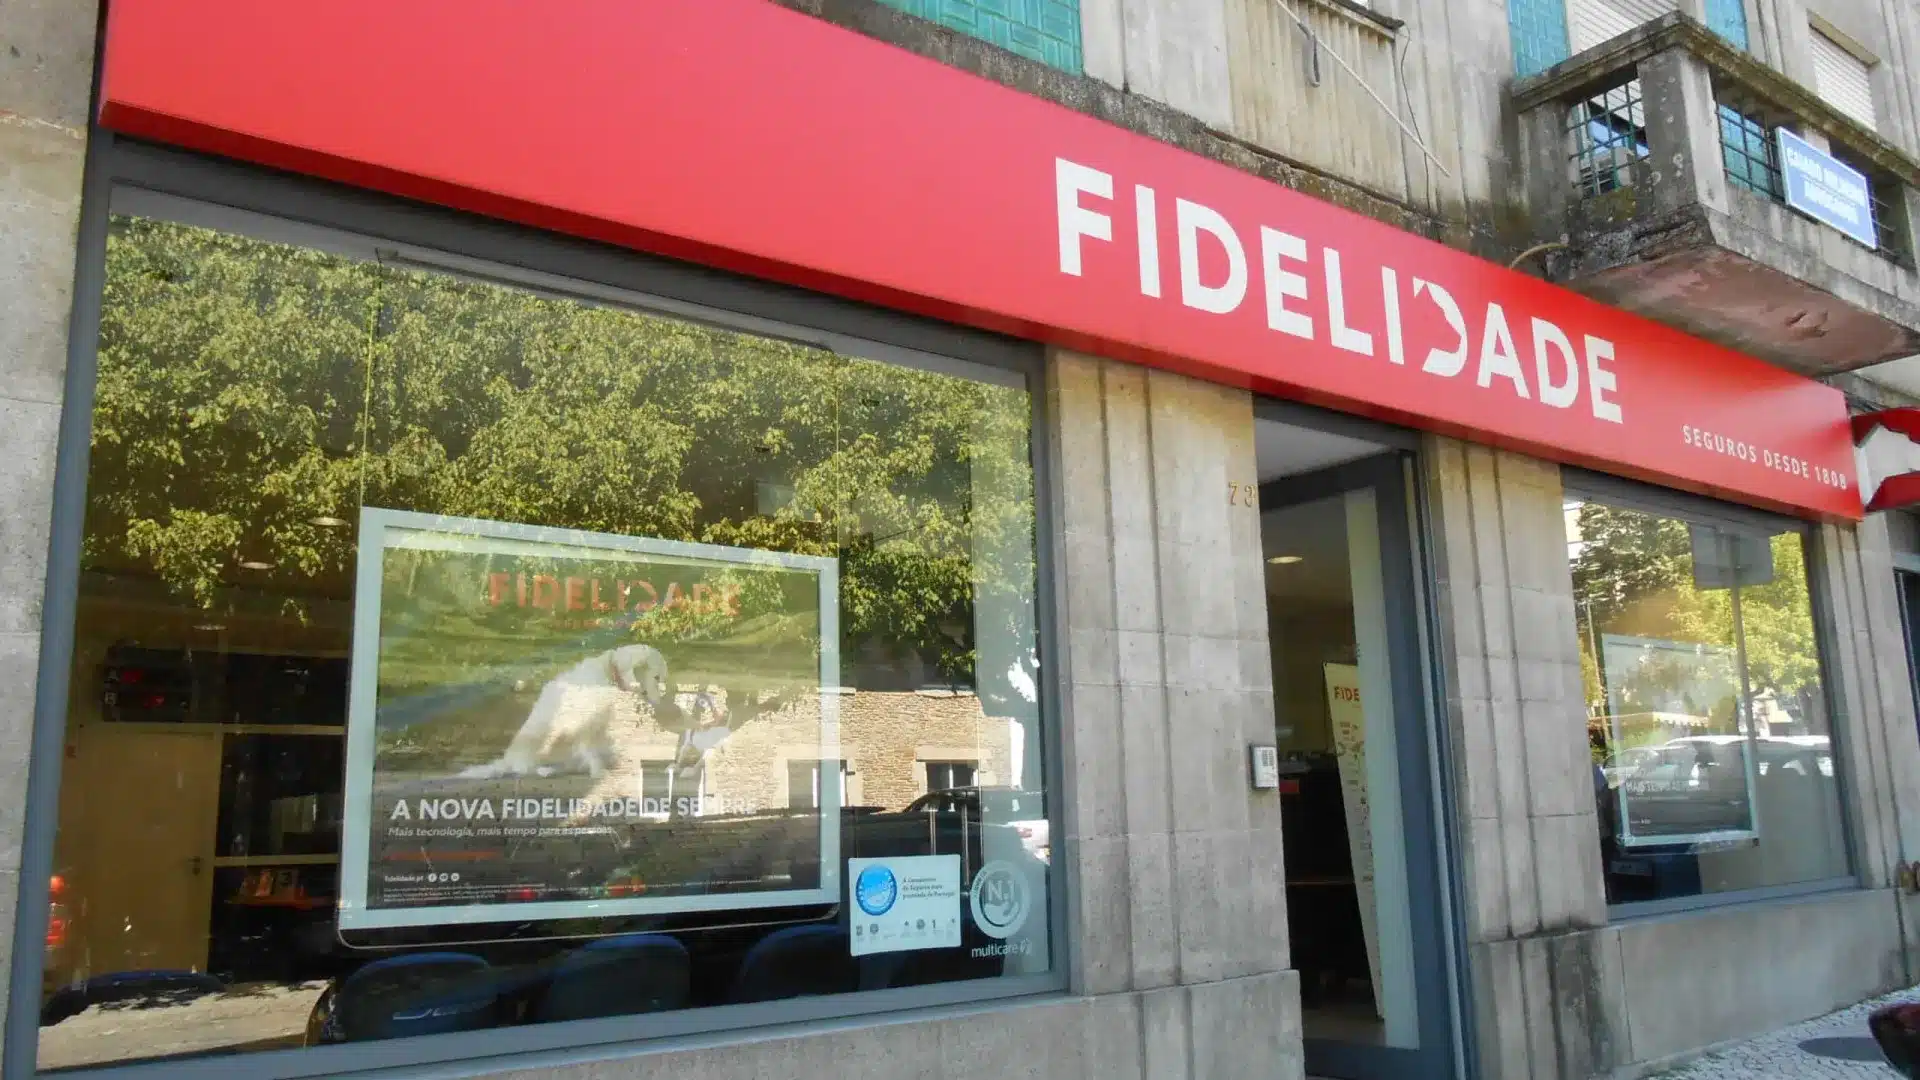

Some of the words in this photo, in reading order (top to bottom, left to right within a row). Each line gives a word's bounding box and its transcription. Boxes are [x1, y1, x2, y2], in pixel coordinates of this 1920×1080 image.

[1055, 157, 1623, 424] FIDELIDADE
[1682, 424, 1757, 463] SEGUROS
[1764, 449, 1810, 479] DESDE
[1815, 465, 1847, 490] 1808
[1228, 480, 1257, 508] 73
[390, 798, 411, 820] A
[419, 798, 495, 820] NOVA
[502, 797, 637, 819] FIDELIDADE
[643, 797, 670, 816] DE
[388, 827, 413, 837] Mais
[416, 826, 475, 838] tecnologia,
[477, 826, 502, 836] mais
[504, 826, 537, 838] tempo
[971, 942, 1019, 959] multicare
